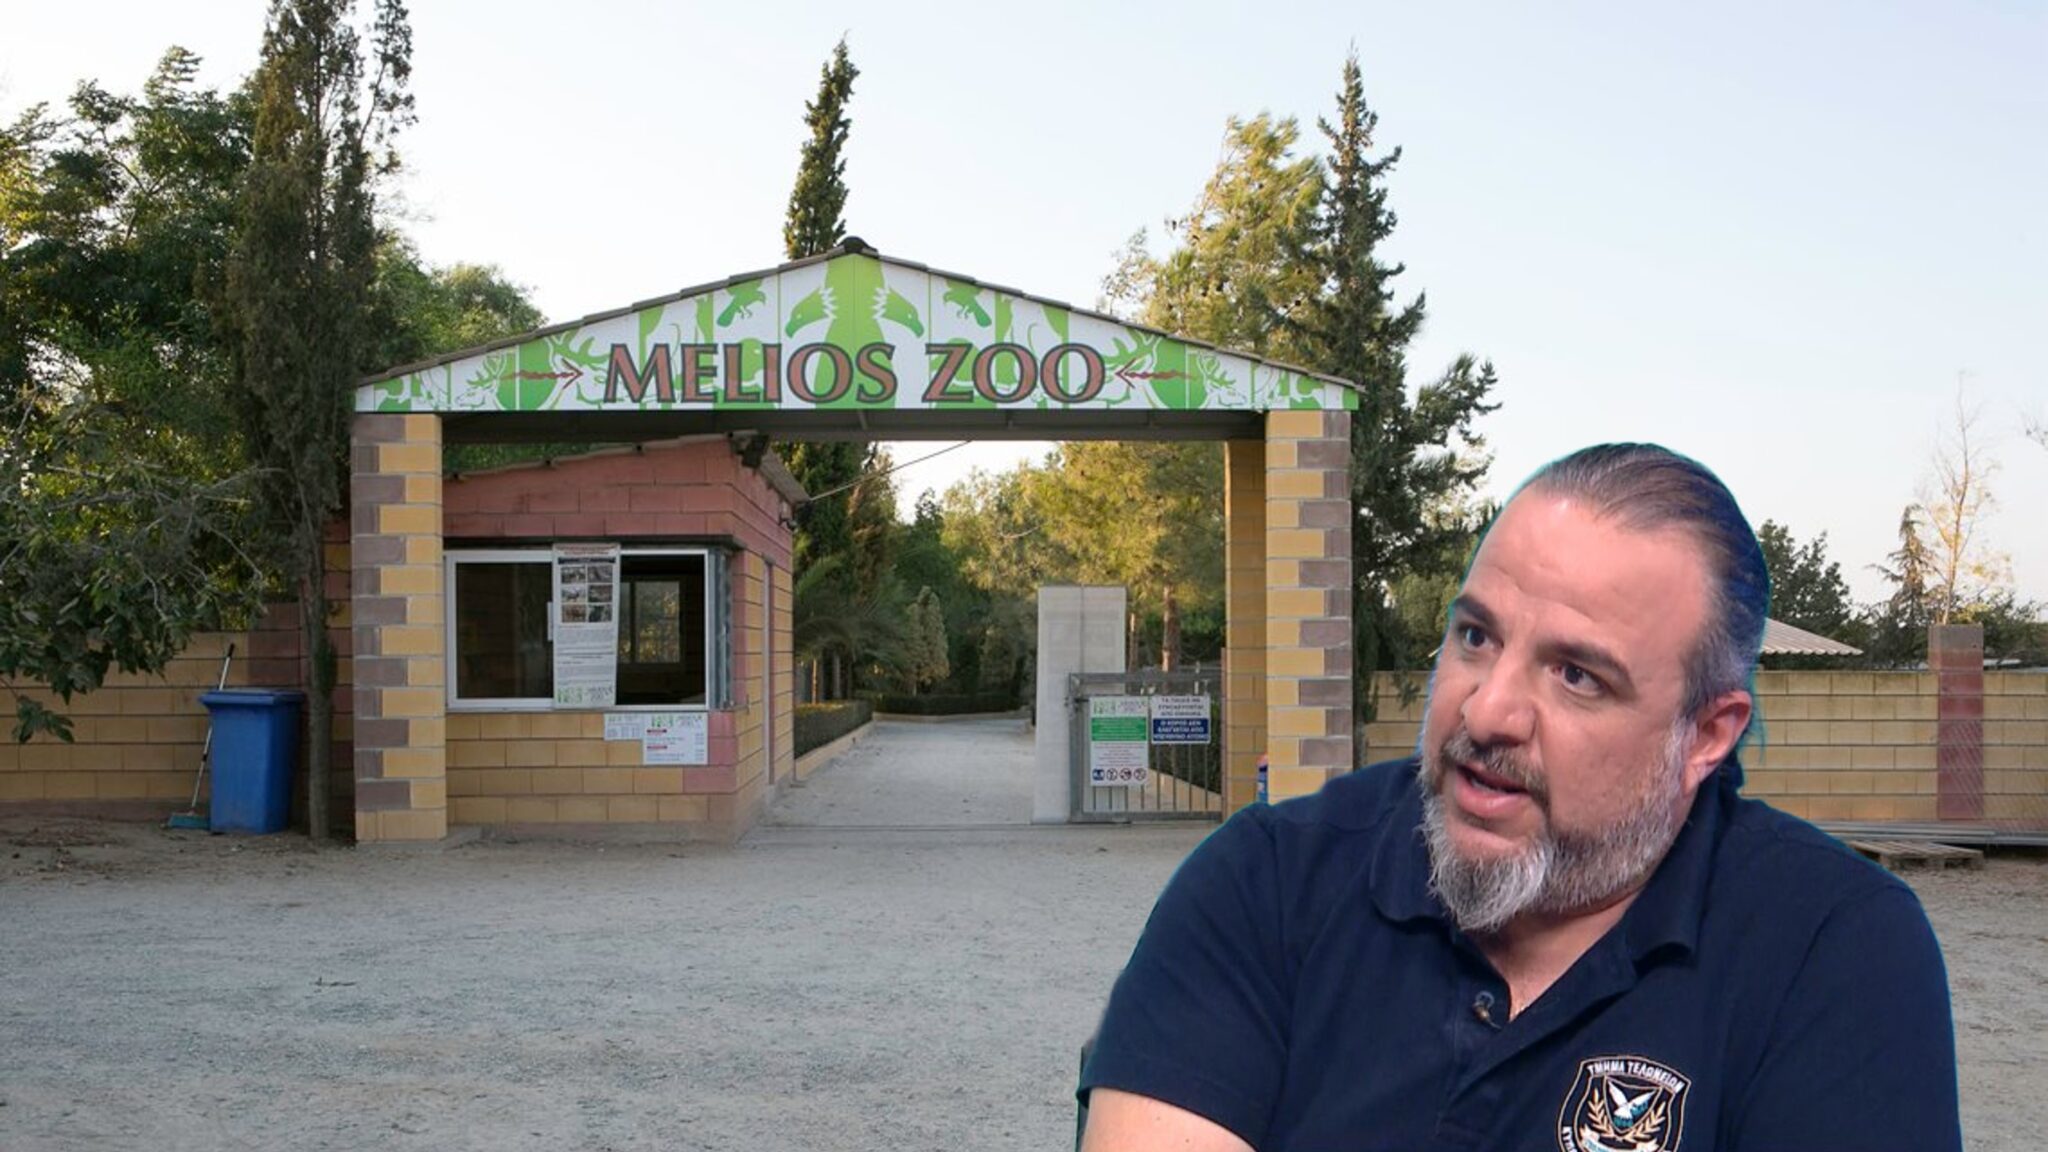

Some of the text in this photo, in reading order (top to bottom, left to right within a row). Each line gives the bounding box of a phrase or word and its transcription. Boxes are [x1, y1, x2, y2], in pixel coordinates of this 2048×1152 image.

[603, 343, 1106, 403] MELIOS ZOO
[1587, 1060, 1685, 1094] ΤΜΗΜΑ ΤΕΛΩΝΕΙΩΝ
